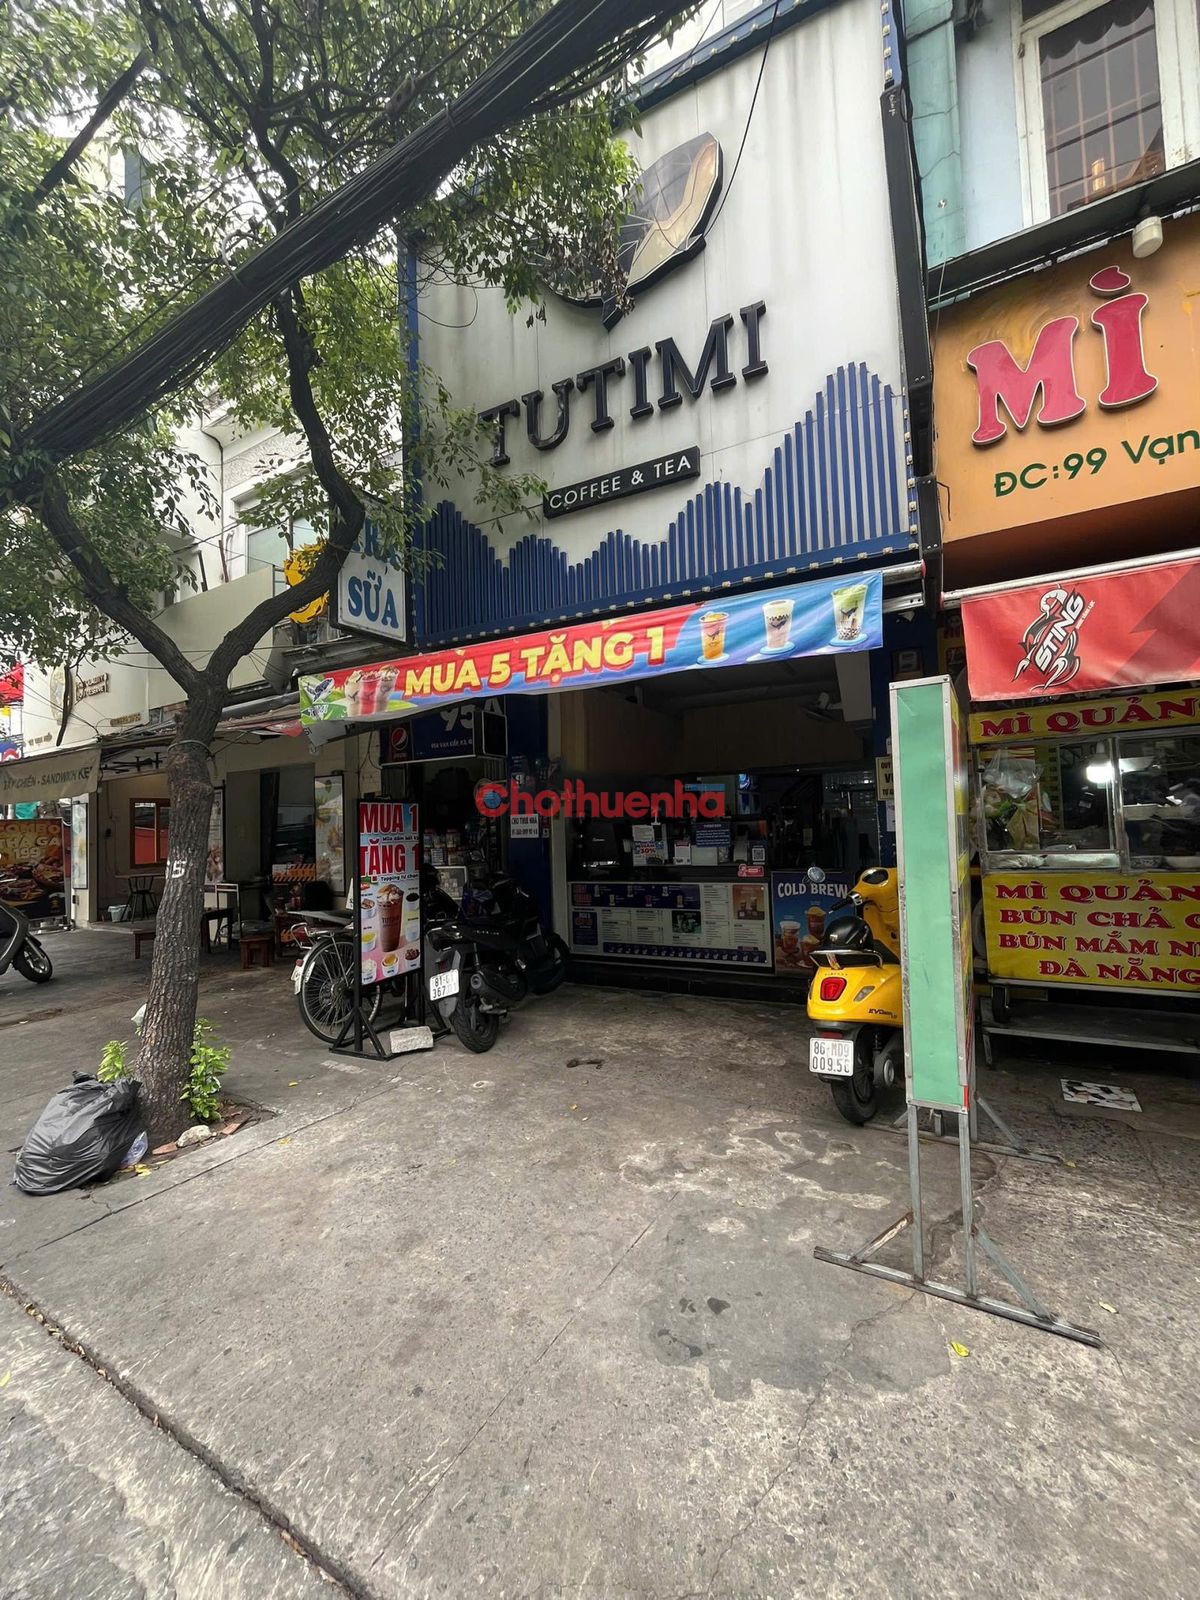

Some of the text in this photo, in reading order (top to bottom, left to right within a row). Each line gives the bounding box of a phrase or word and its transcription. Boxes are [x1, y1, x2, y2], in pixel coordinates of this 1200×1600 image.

[478, 300, 769, 467] TUTIMI
[1121, 429, 1200, 464] Vạn
[549, 455, 691, 509] COFFEE & TEA
[348, 569, 399, 629] SỮA
[1034, 593, 1085, 672] STING
[489, 652, 511, 684] 5
[521, 633, 635, 683] TẶNG
[647, 626, 665, 660] 1
[980, 711, 1031, 737] MÌ
[360, 803, 418, 834] MUA 1
[360, 838, 406, 882] TẶNG
[778, 882, 848, 899] COLD BREW
[995, 879, 1200, 904] MÌ QUẢN
[1000, 906, 1077, 926] BÚN
[1087, 906, 1174, 929] CHẢ
[998, 930, 1200, 957] BÚN MẮM N
[1039, 957, 1089, 978] ĐÀ
